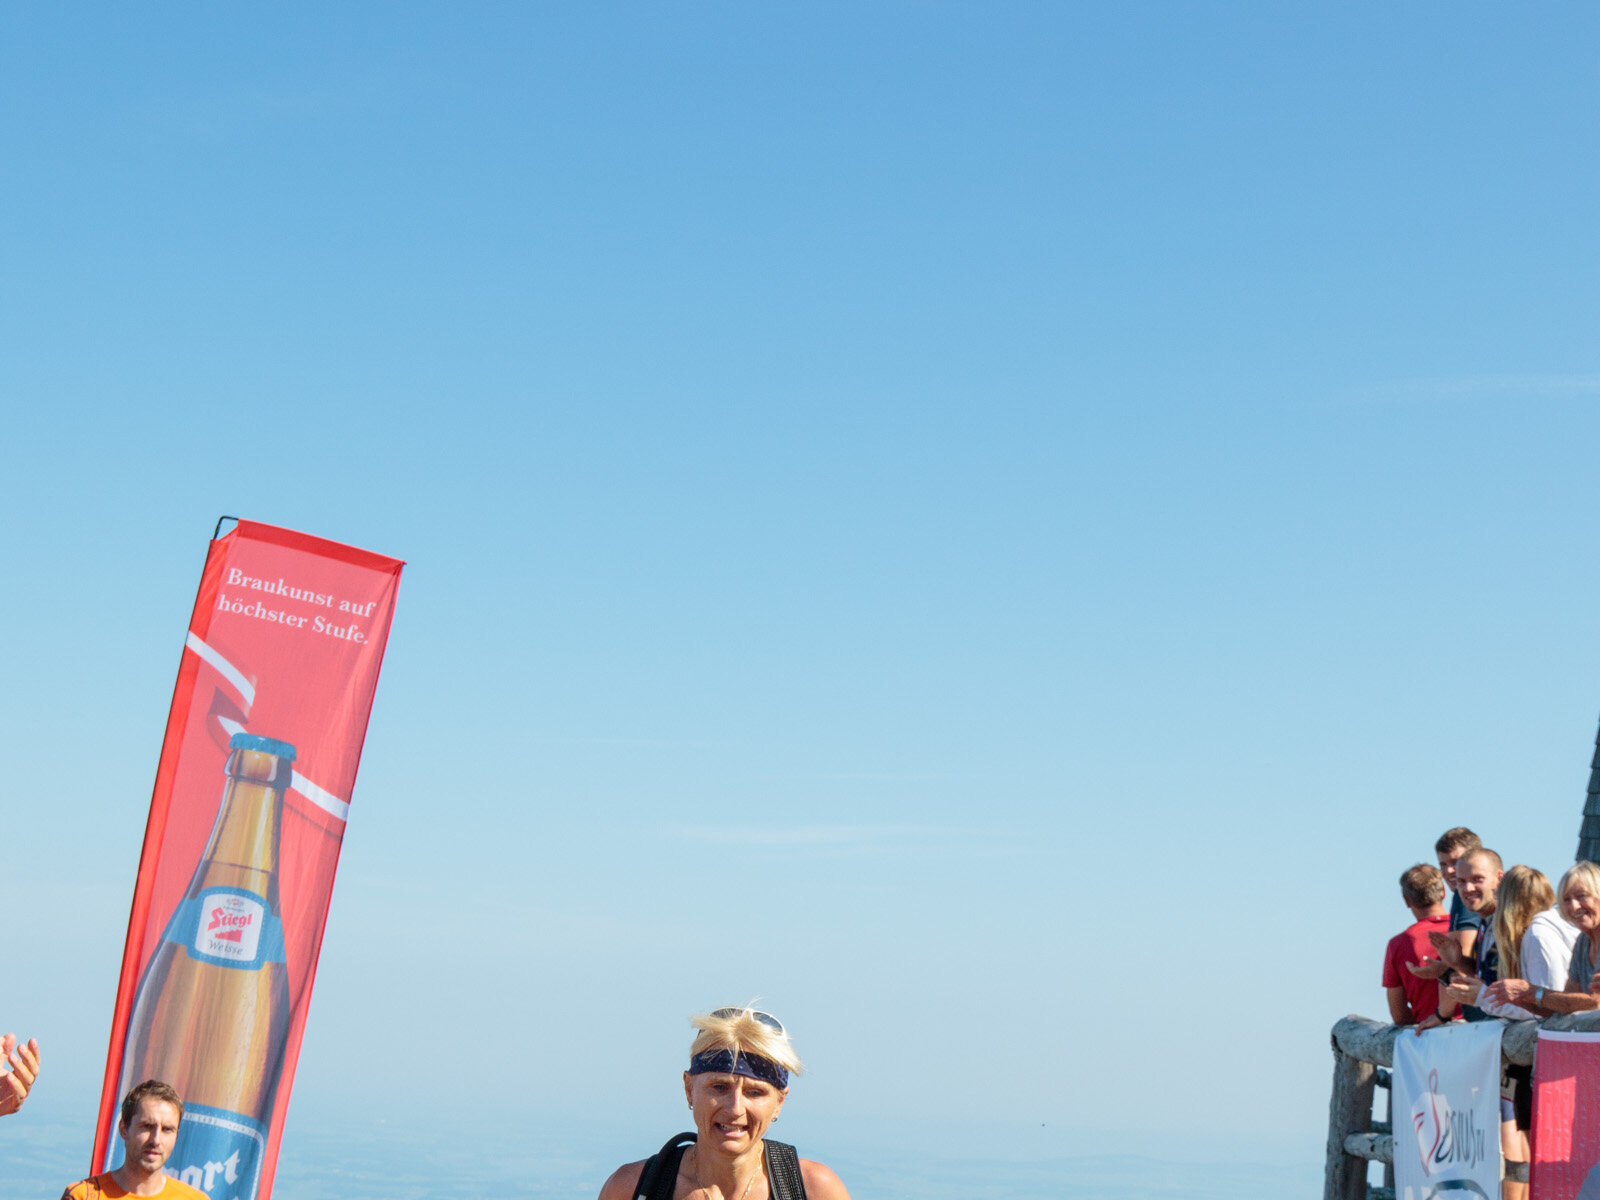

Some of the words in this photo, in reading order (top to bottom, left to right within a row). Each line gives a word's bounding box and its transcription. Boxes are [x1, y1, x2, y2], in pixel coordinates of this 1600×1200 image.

[227, 567, 334, 608] Braukunst
[339, 600, 377, 618] auf
[217, 594, 308, 628] höchster
[312, 615, 369, 644] Stufe.
[207, 907, 253, 931] Stiegl
[208, 940, 244, 954] Weisse
